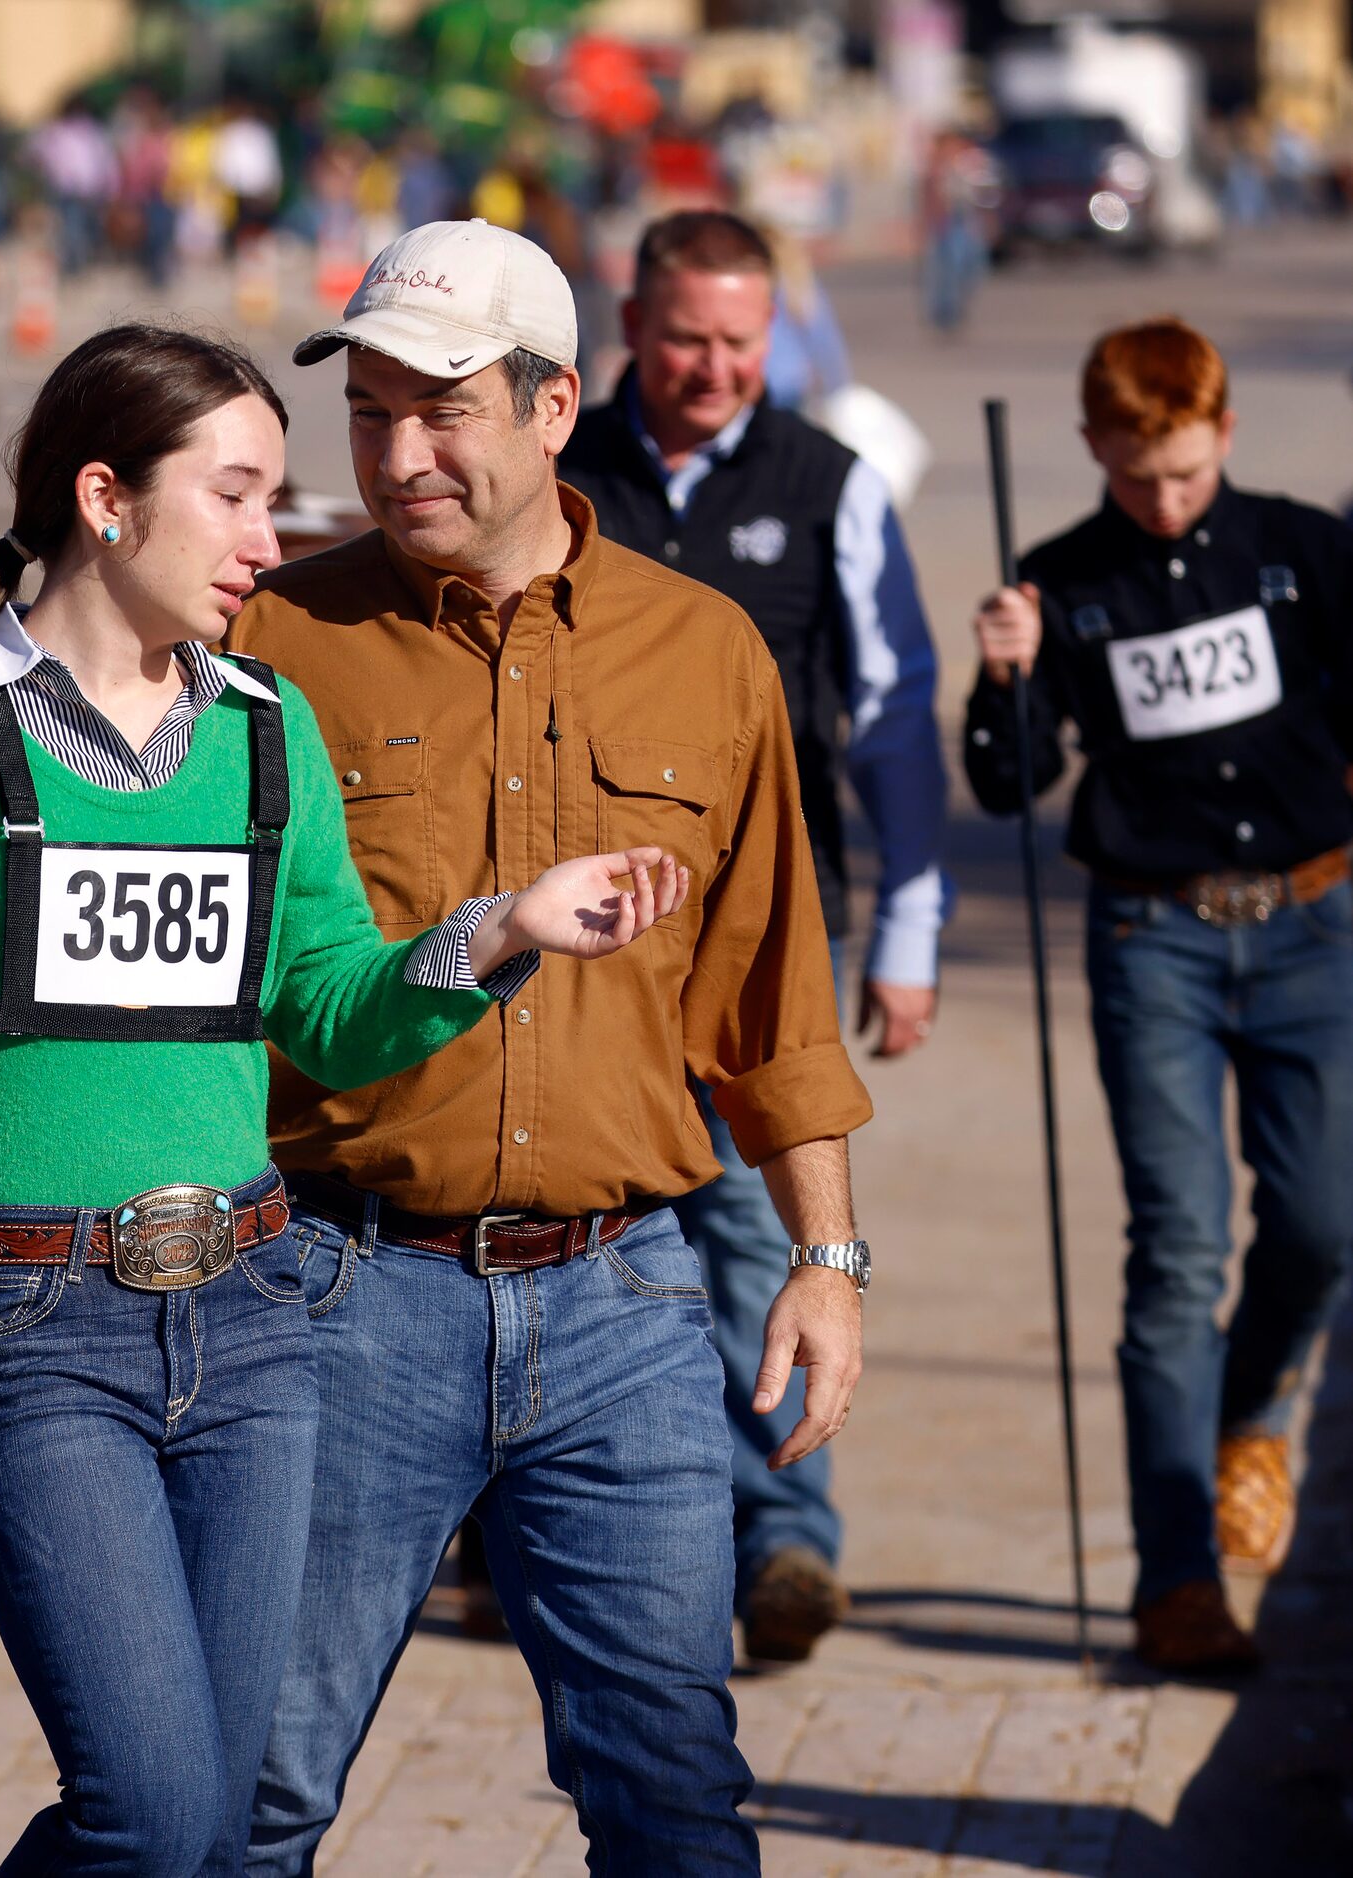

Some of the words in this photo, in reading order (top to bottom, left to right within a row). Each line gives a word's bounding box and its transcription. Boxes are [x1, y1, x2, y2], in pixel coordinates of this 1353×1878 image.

[409, 270, 453, 296] Oaks
[1130, 628, 1258, 709] 3423
[388, 737, 417, 745] PONCHO
[63, 869, 230, 964] 3585
[138, 1215, 211, 1244] SHOWMANSHIP
